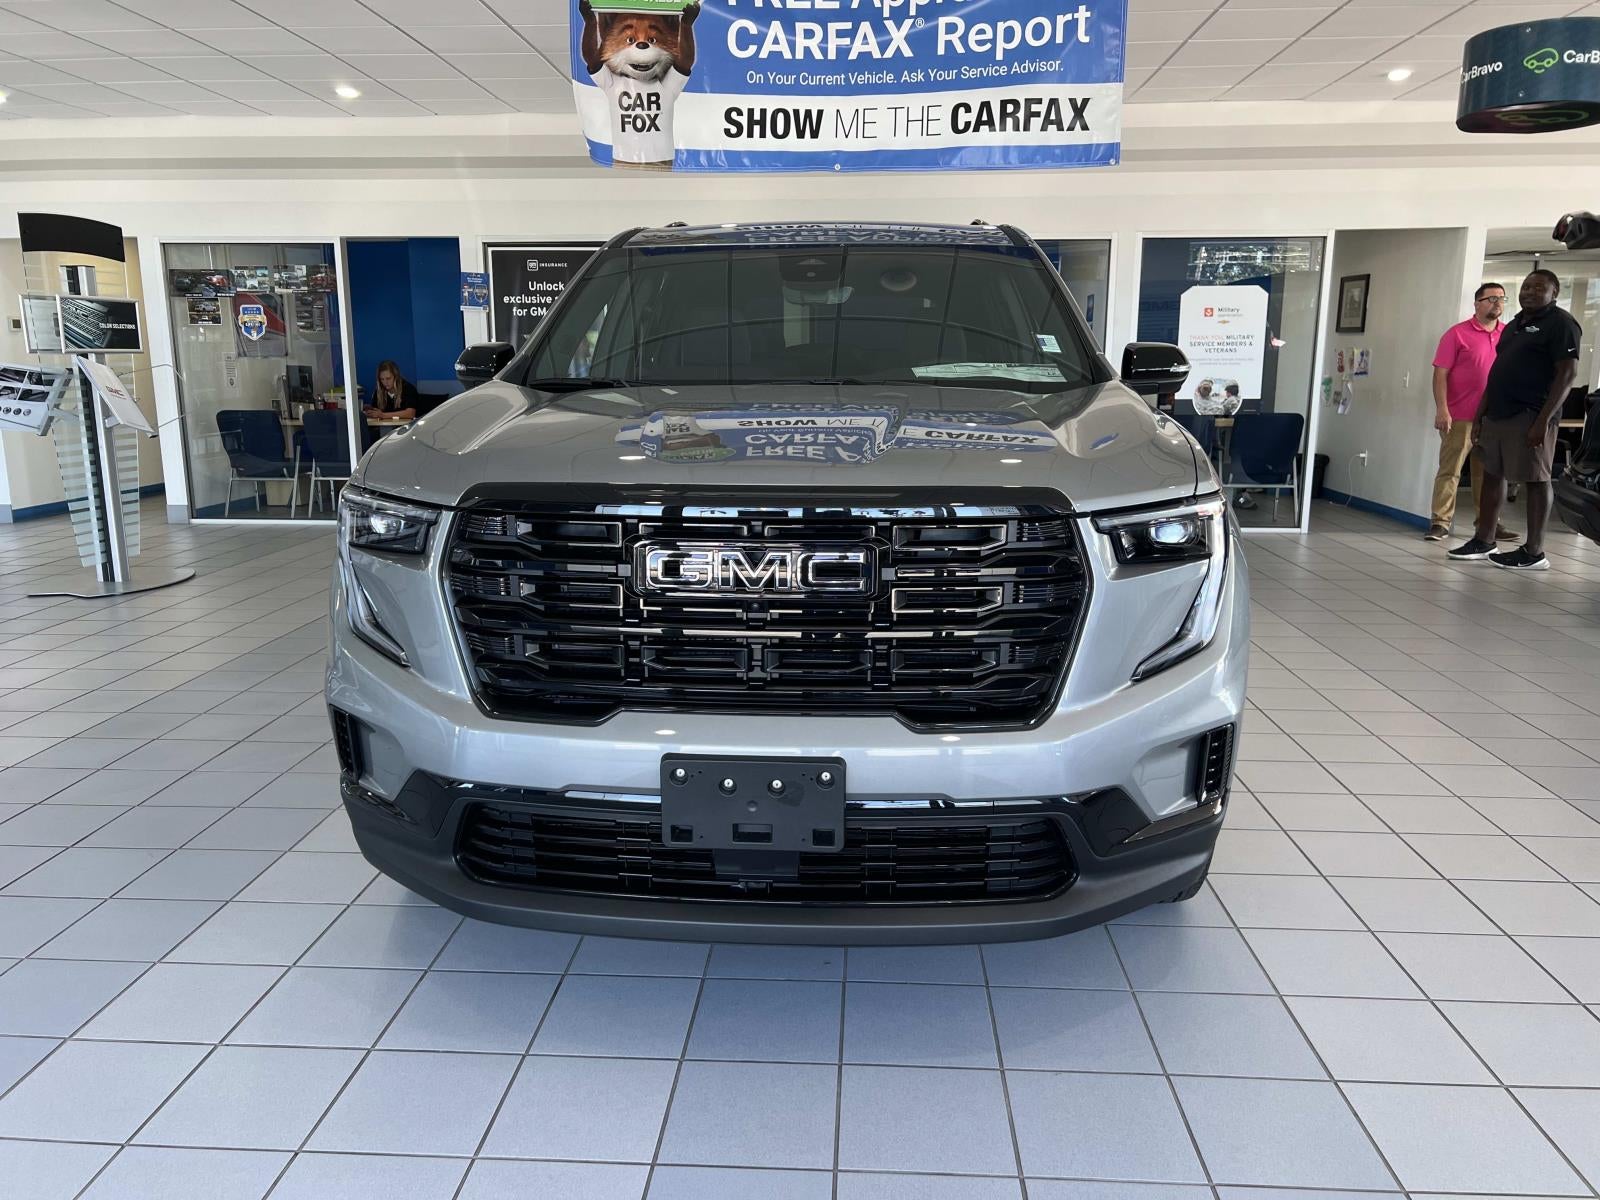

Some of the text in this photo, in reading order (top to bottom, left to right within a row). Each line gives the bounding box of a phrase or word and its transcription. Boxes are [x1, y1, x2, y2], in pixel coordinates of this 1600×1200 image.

[937, 5, 1091, 60] Report
[746, 59, 1064, 85] On Your Current Vehicle. Ask Your Service Advisor.
[618, 91, 661, 112] CAR
[620, 113, 661, 133] FOX
[723, 97, 1092, 140] SHOW ME THE CARFAX
[528, 281, 565, 291] Unlock
[503, 294, 553, 304] exclusive
[512, 306, 528, 316] for
[645, 550, 866, 591] GMC
